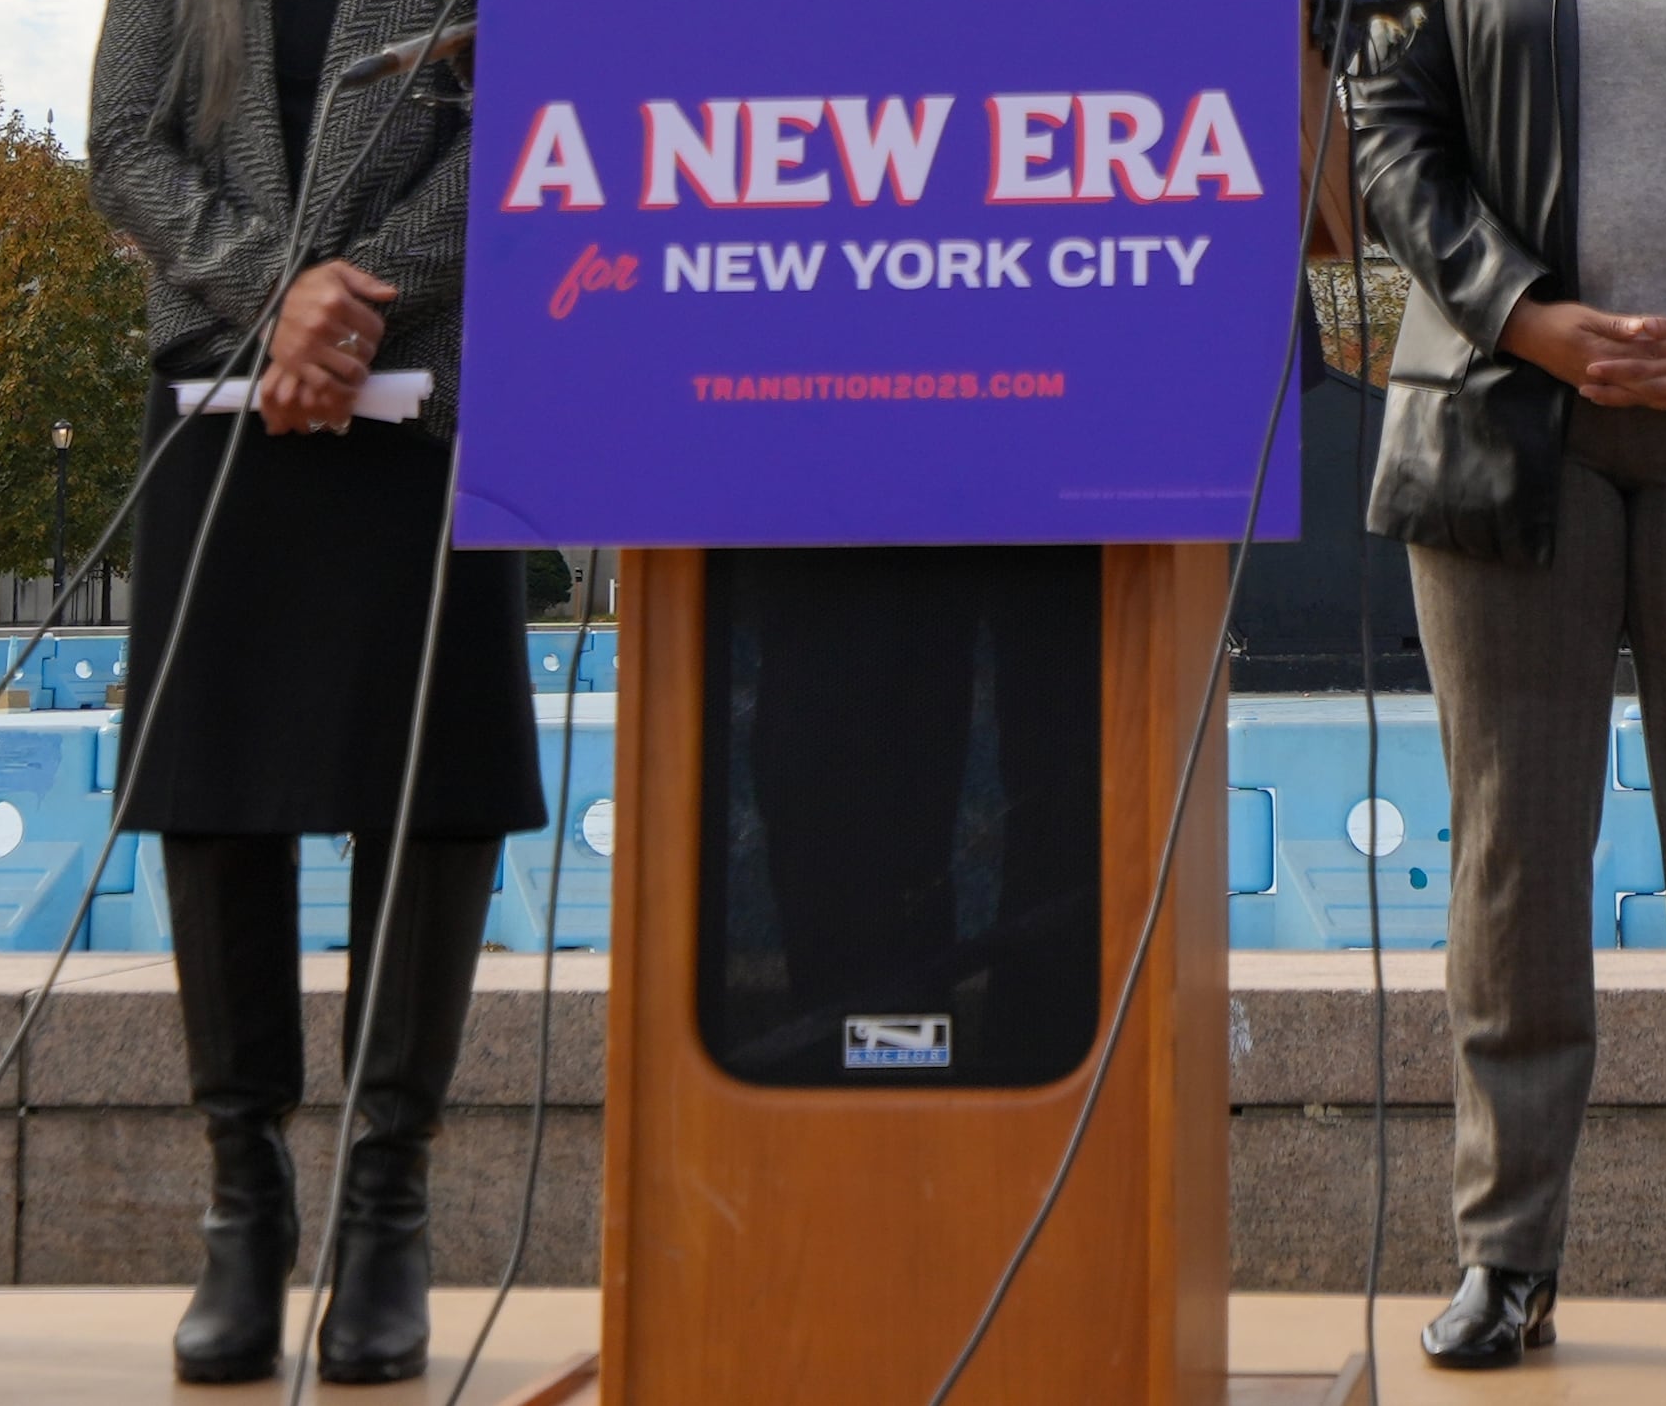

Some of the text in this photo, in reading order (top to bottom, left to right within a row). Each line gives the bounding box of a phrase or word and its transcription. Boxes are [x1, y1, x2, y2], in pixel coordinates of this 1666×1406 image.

[501, 89, 1264, 212] A NEW ERA
[549, 235, 1211, 320] for NEW YORK CITY
[692, 372, 1066, 401] TRANSITION2025.COM
